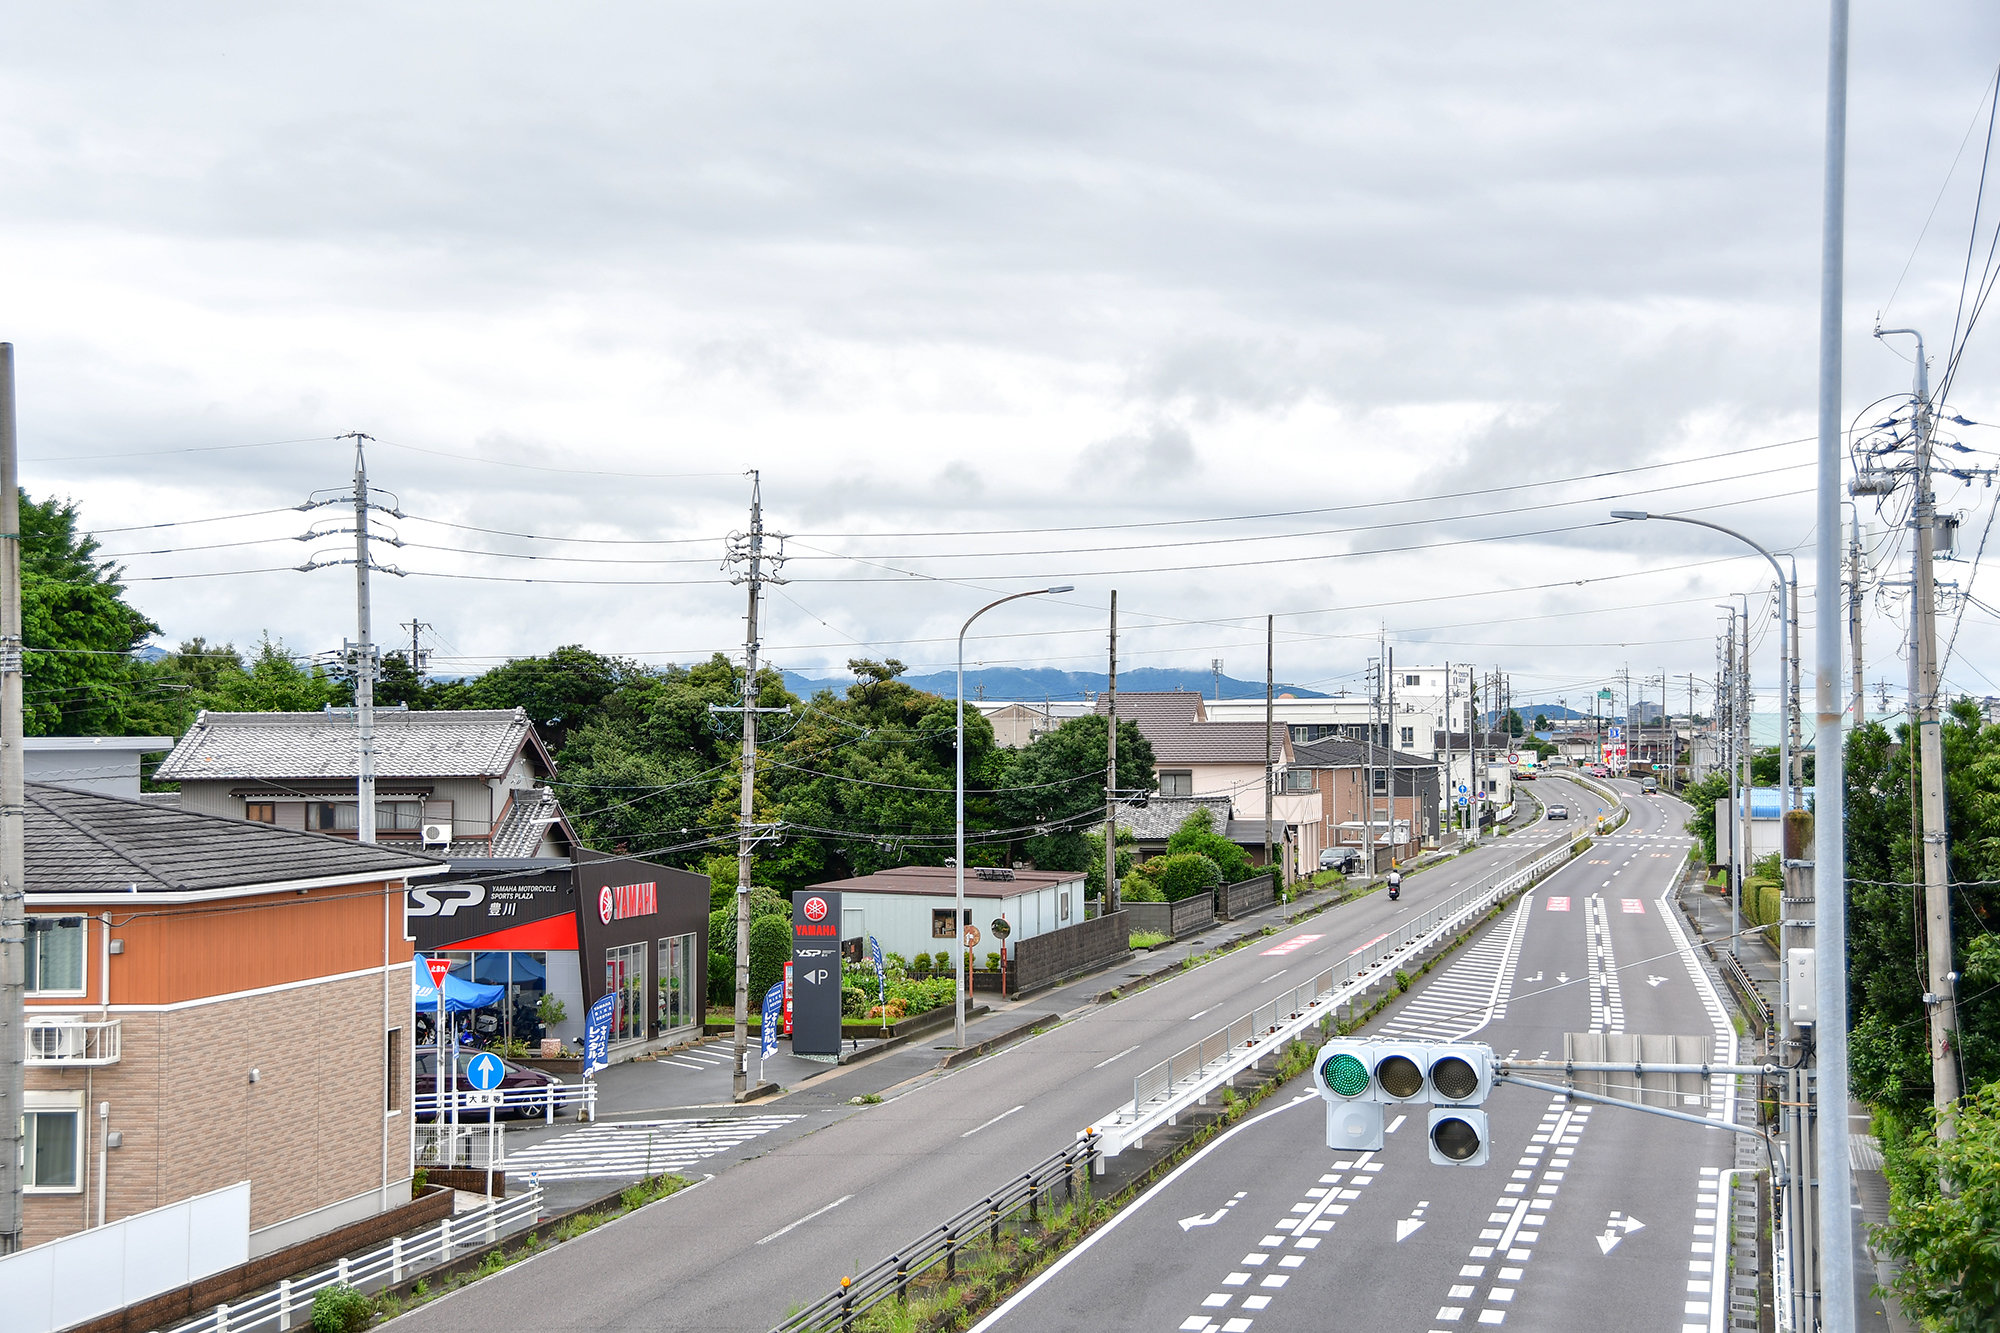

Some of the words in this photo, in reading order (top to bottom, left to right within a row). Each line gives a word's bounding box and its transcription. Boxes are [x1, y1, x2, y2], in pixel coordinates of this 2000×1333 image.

[518, 885, 557, 893] MOTORCYCLE
[408, 884, 486, 916] SP
[613, 881, 658, 920] YAMAHA
[488, 903, 517, 916] 豊川
[795, 924, 837, 937] YAMAHA
[796, 949, 821, 958] YSP
[431, 965, 446, 973] 止まれ
[818, 969, 829, 985] P
[588, 1026, 600, 1060] レンタル
[469, 1095, 501, 1104] 大型等
